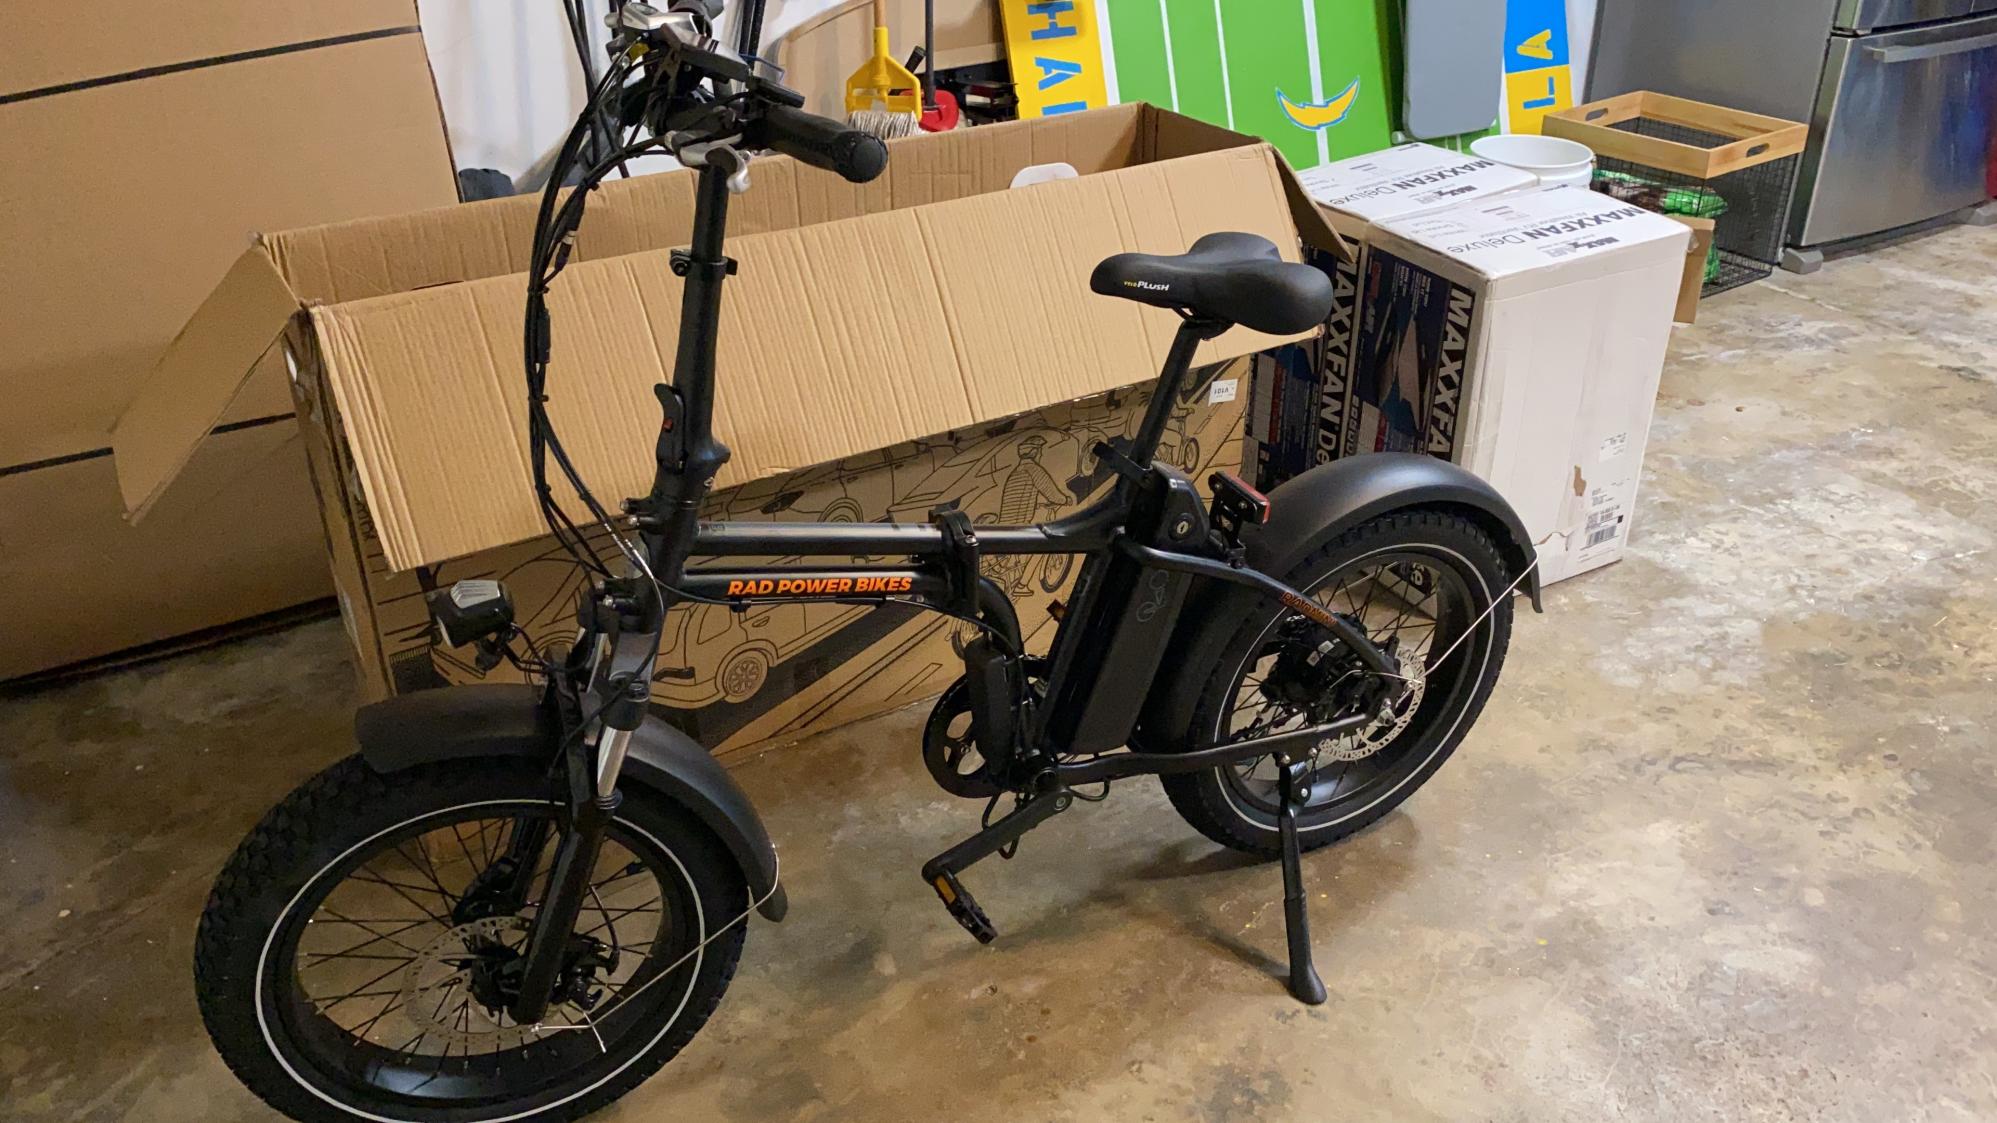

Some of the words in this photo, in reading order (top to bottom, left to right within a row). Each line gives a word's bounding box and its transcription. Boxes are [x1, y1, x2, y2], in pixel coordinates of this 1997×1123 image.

[1516, 29, 1555, 109] LA
[1393, 159, 1496, 191] MAXXFAN
[1329, 184, 1398, 205] Deluxe
[1521, 206, 1647, 239] MAXXFAN
[1447, 233, 1527, 254] Deluxe
[1137, 281, 1170, 291] PLUSH
[1319, 240, 1361, 425] MAXXFAN
[1427, 287, 1474, 457] MAXXFA
[1315, 430, 1338, 466] De
[727, 580, 775, 595] RAD
[776, 578, 852, 594] POWER
[855, 576, 912, 592] BIKES
